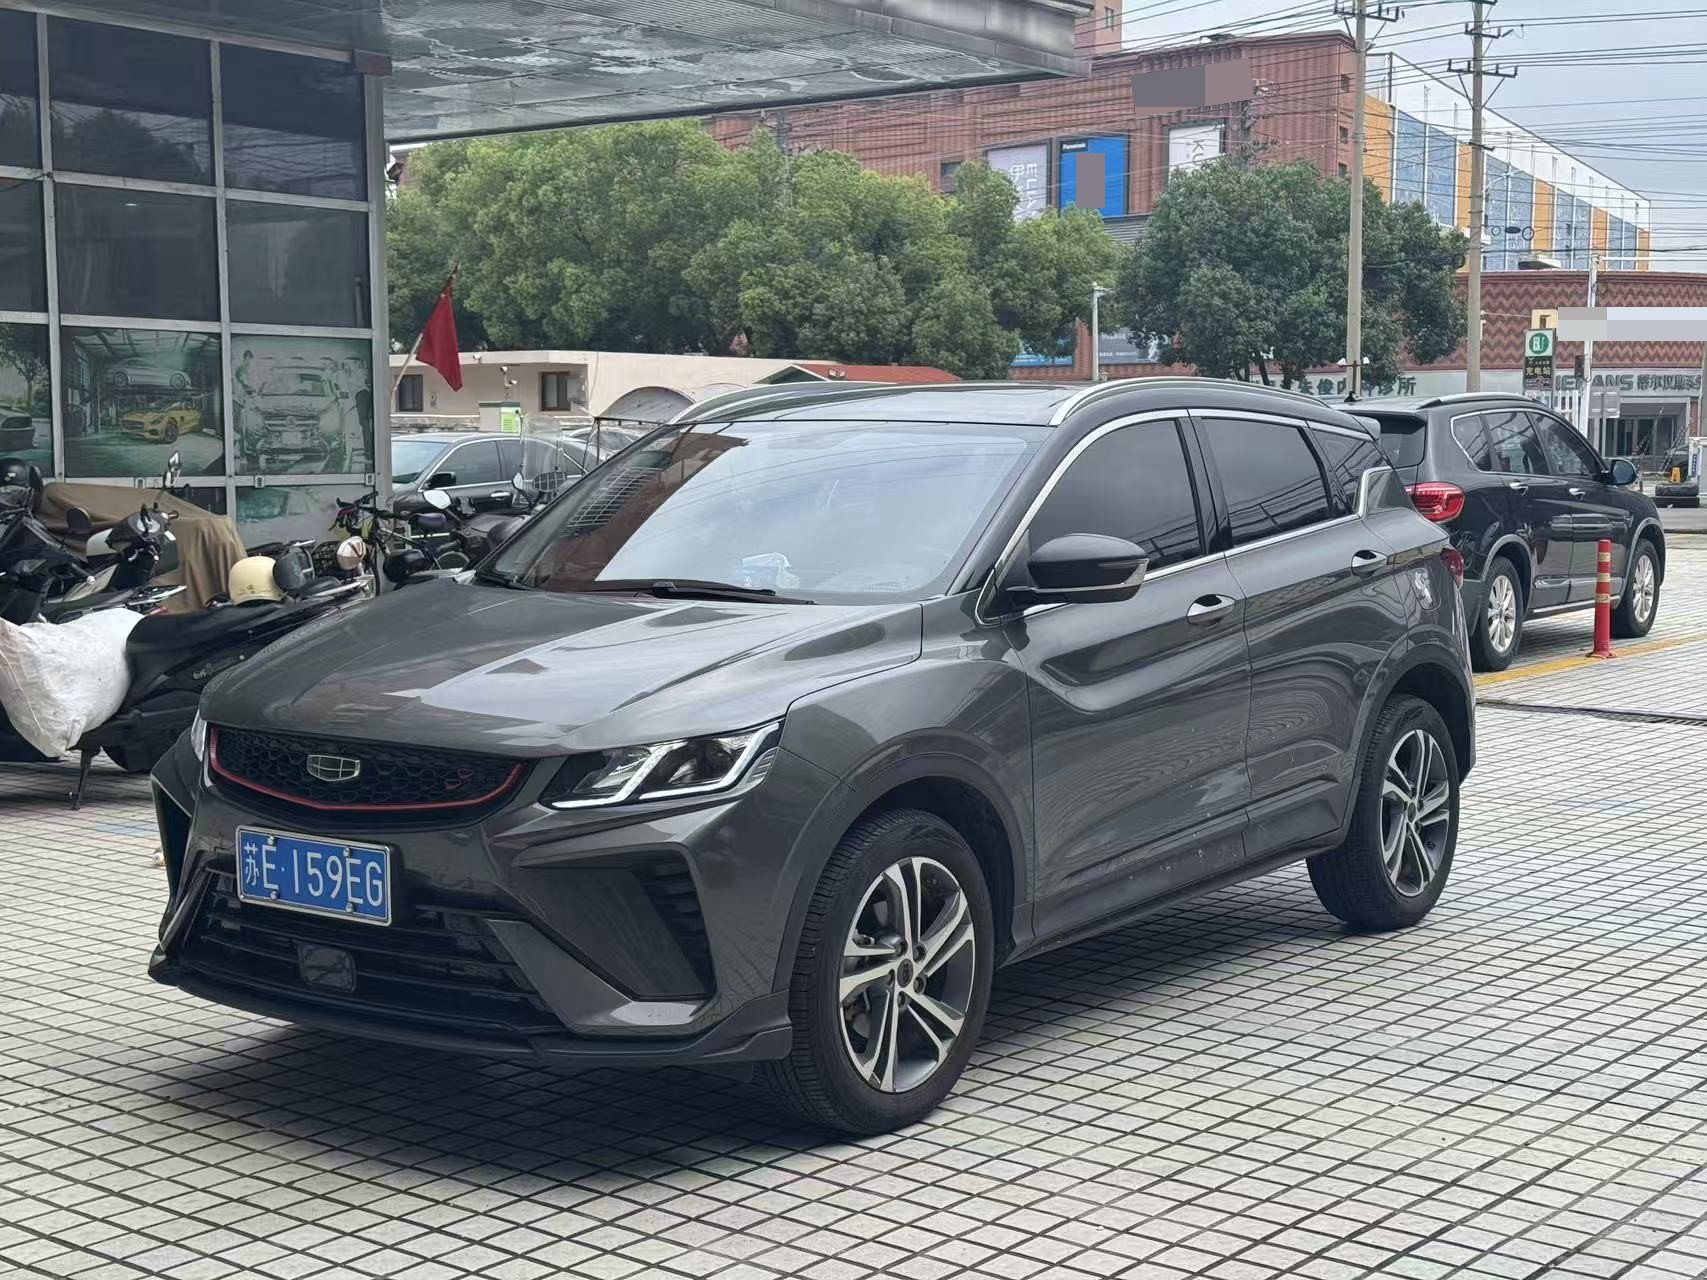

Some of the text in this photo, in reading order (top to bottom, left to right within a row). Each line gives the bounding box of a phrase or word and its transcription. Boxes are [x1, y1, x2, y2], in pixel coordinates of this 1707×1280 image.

[1525, 366, 1551, 376] 充电站
[243, 841, 384, 907] 苏E·159EG
